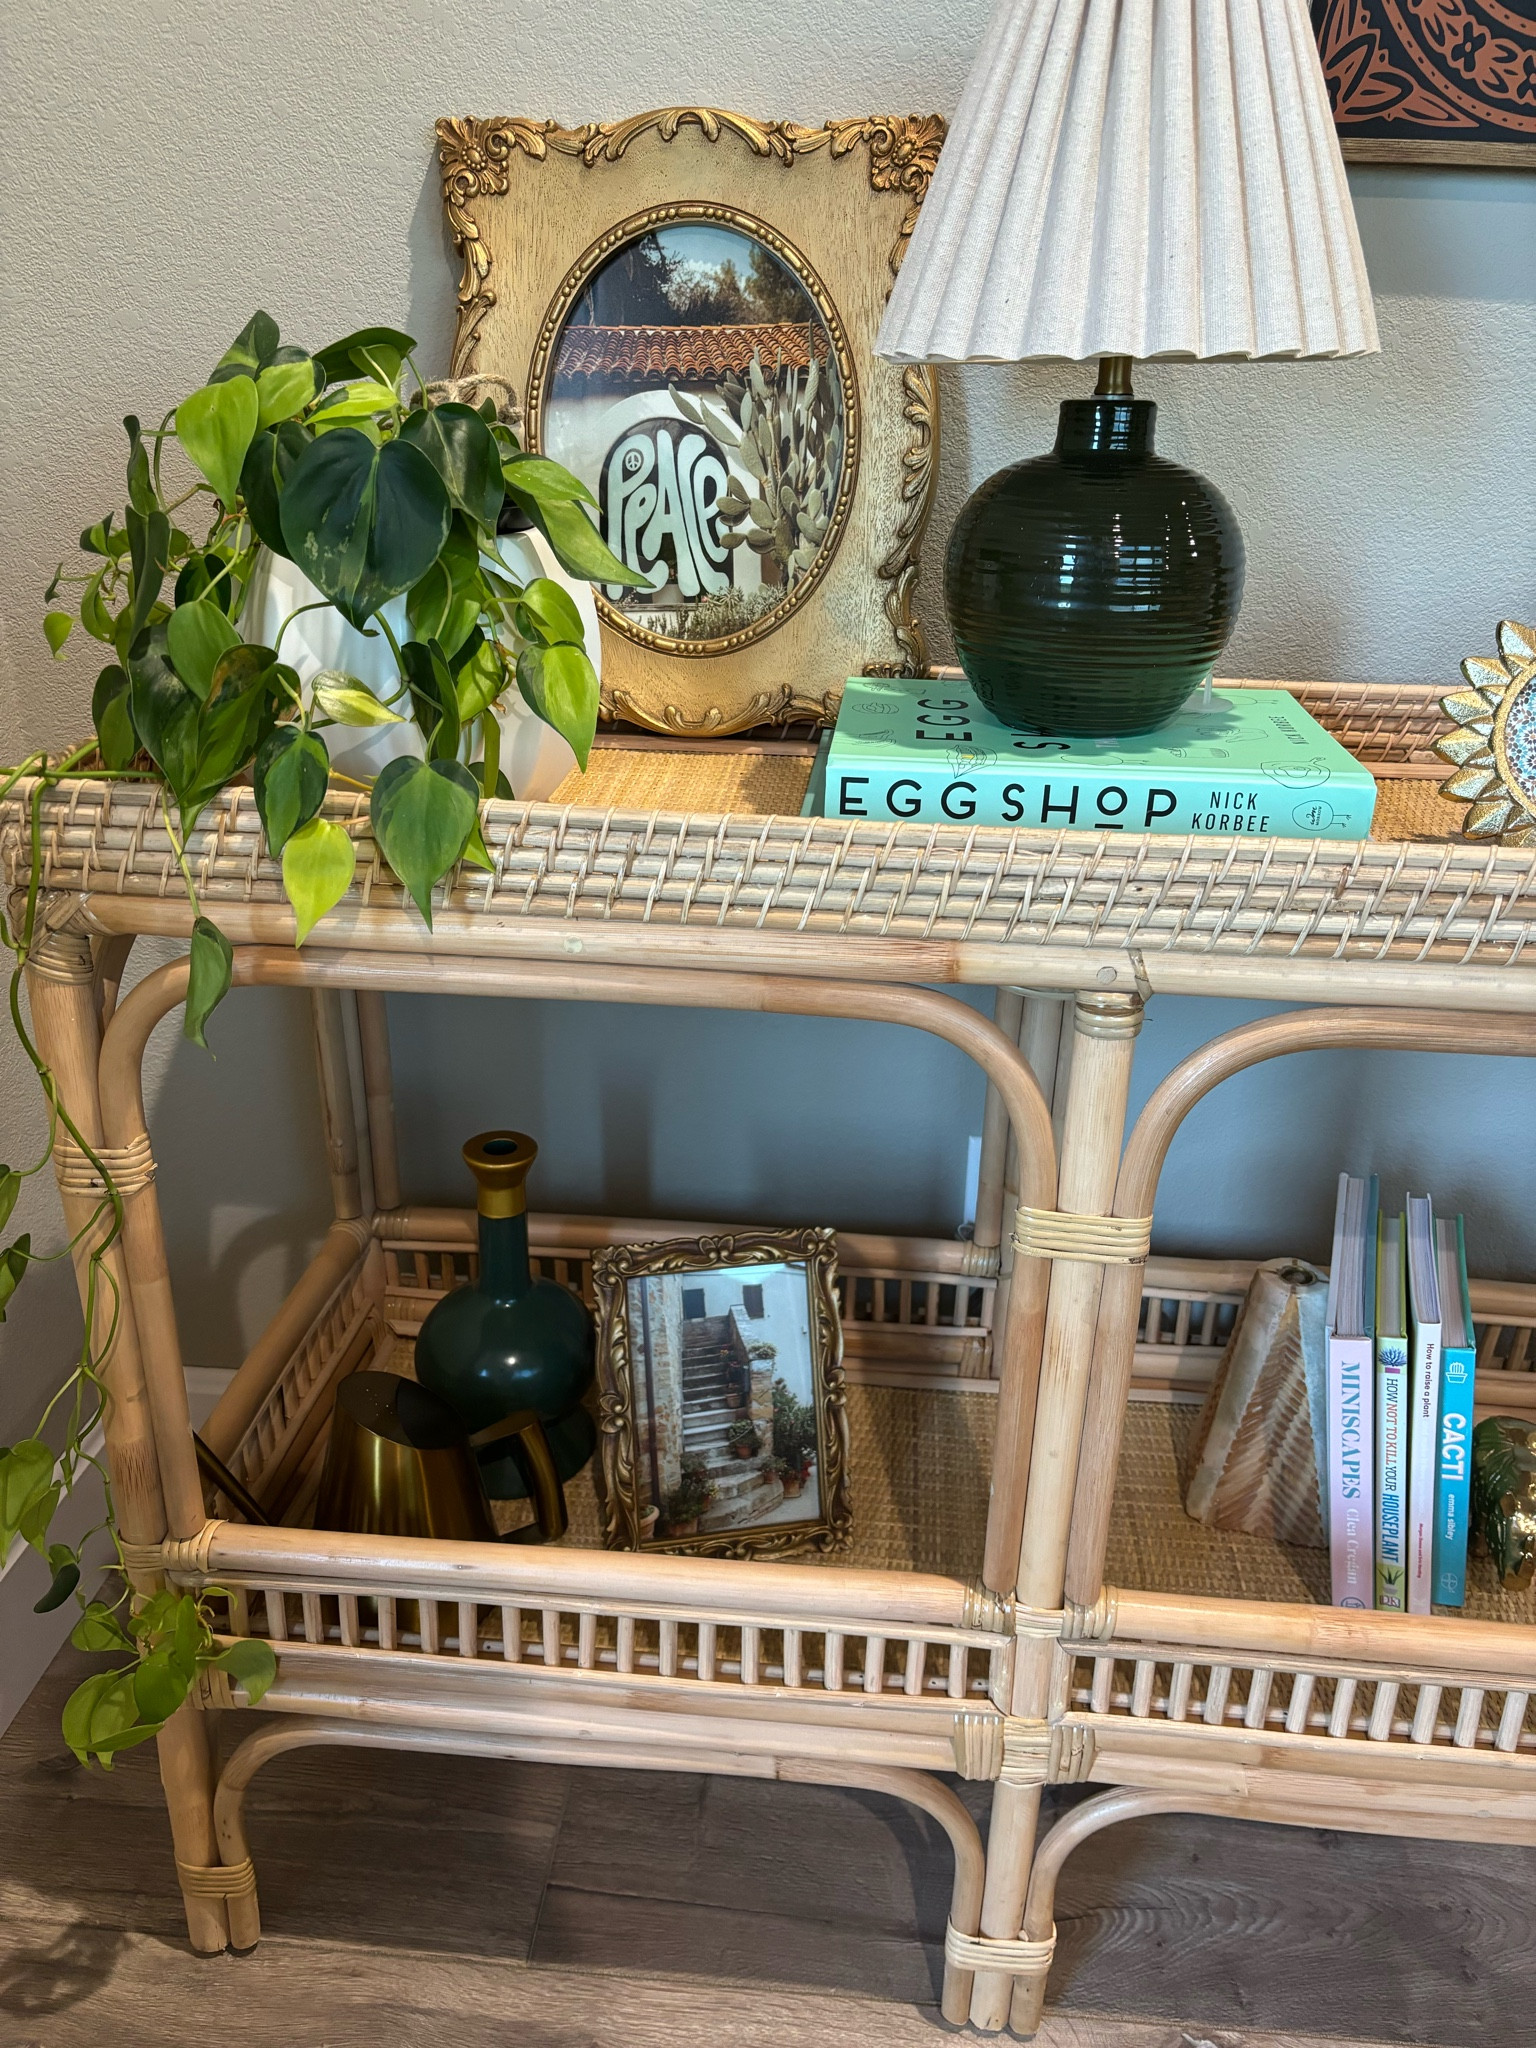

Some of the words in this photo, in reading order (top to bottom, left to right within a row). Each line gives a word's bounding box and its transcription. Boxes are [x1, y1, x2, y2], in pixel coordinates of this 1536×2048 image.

[915, 698, 972, 741] EGG
[1209, 791, 1258, 811] NICK
[1191, 812, 1270, 833] KORBEE
[1426, 1343, 1435, 1361] How
[1425, 1361, 1433, 1370] to
[1386, 1378, 1398, 1402] HOW
[1424, 1372, 1433, 1391] raise
[1386, 1403, 1398, 1425] NOT
[1421, 1397, 1430, 1418] plant
[1341, 1361, 1360, 1498] MINISCAPES
[1386, 1426, 1397, 1440] TO
[1385, 1441, 1397, 1465] KILL
[1441, 1413, 1466, 1480] CACTI
[1385, 1465, 1397, 1491] YOUR
[1447, 1493, 1456, 1517] emma
[1346, 1508, 1360, 1536] Clea
[1381, 1492, 1400, 1563] HOUSEPLANT
[1445, 1518, 1456, 1540] sibley
